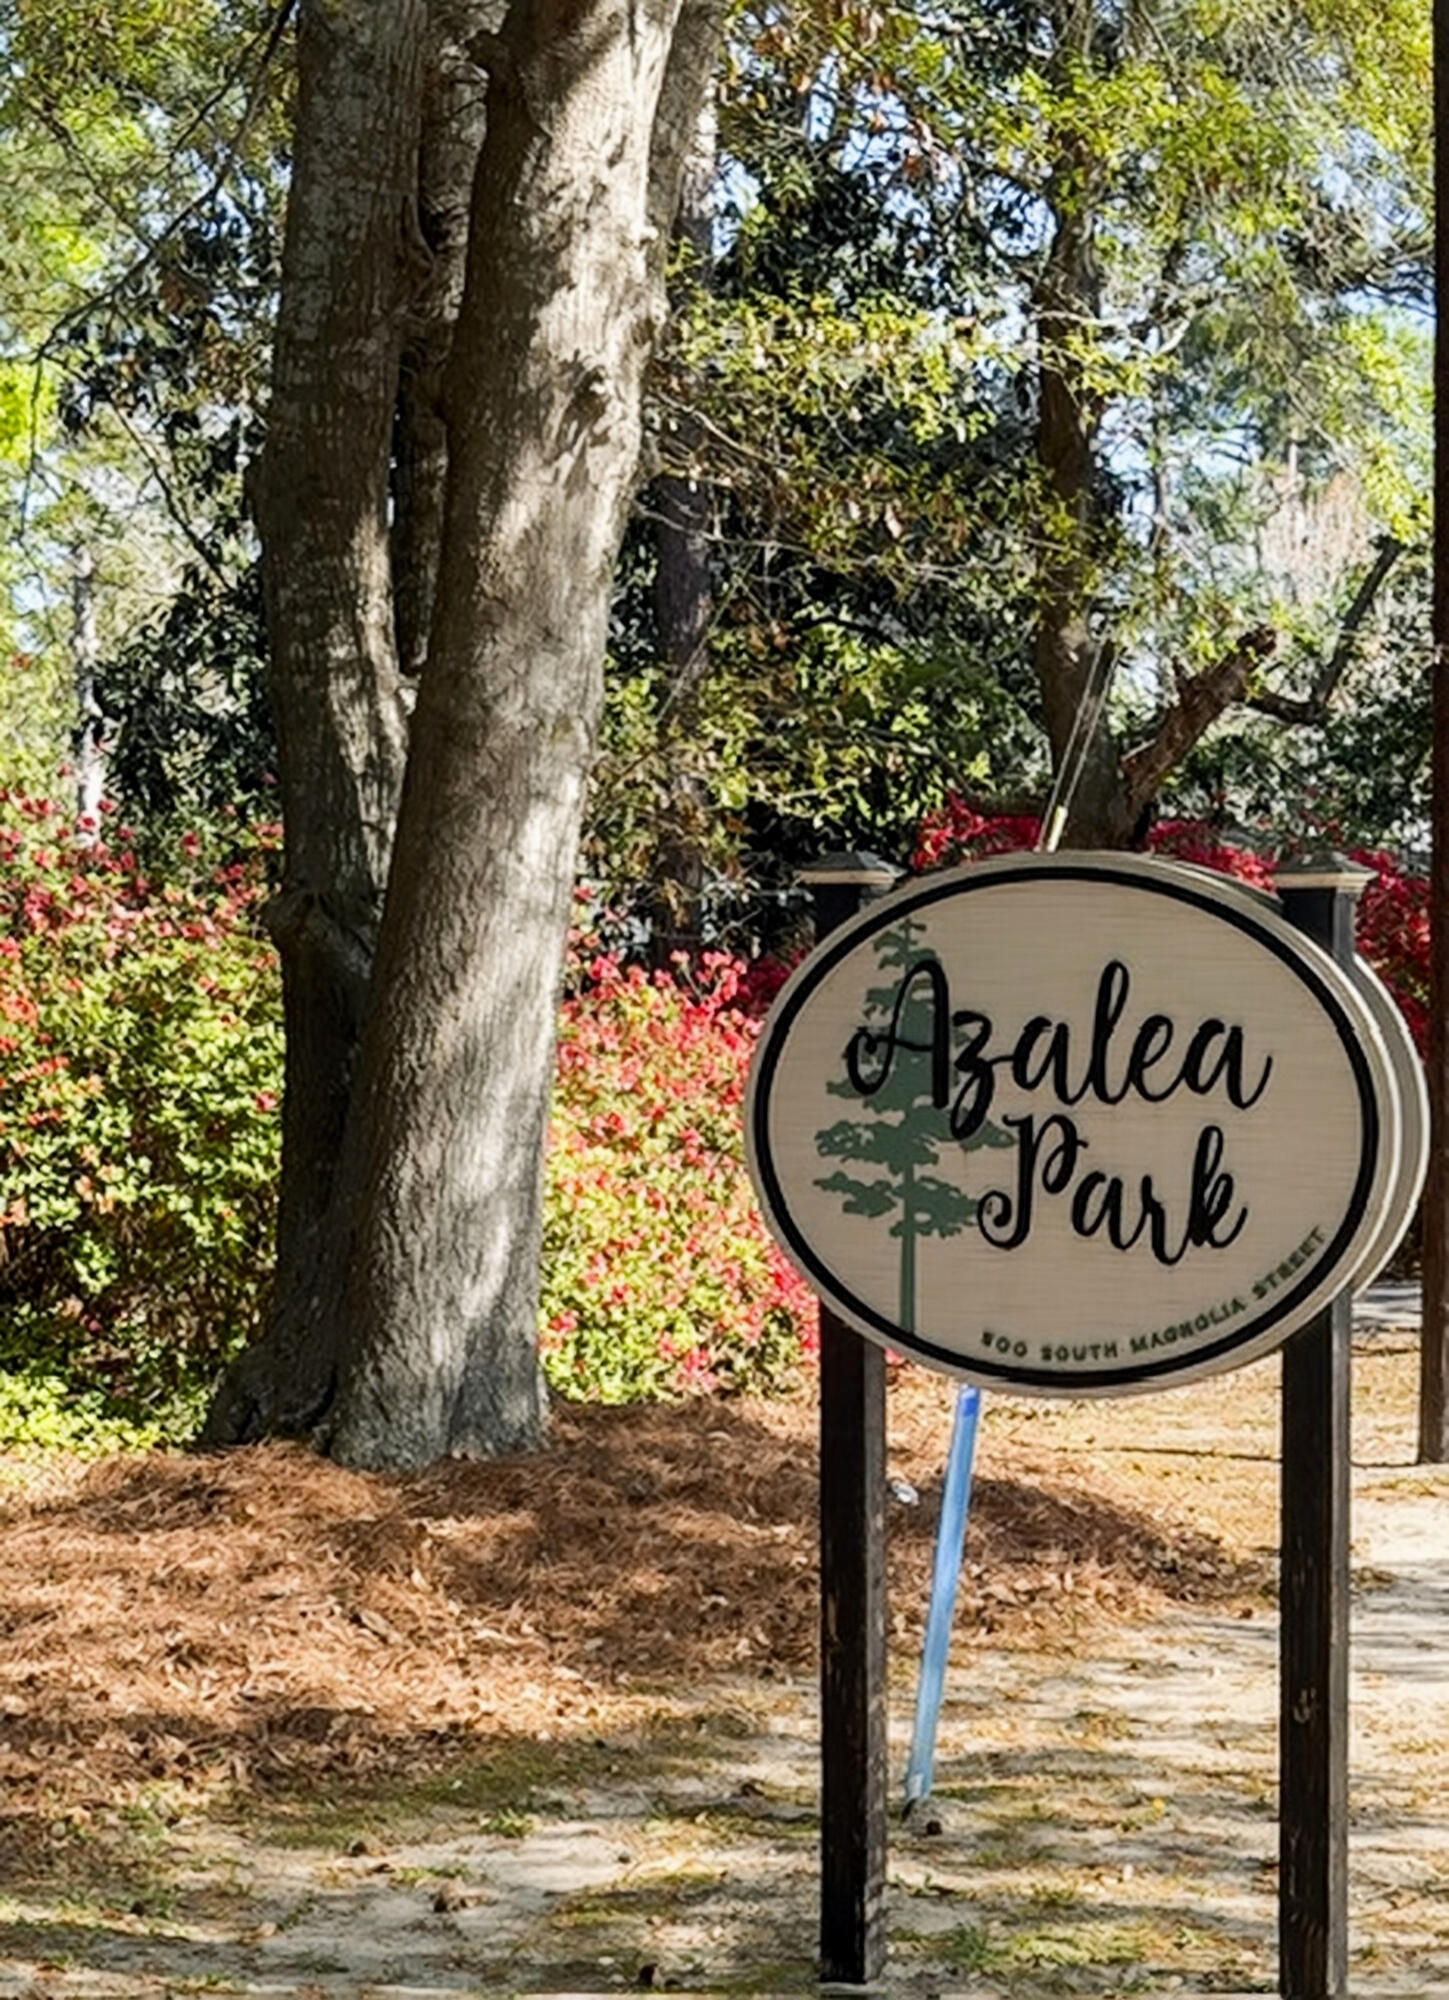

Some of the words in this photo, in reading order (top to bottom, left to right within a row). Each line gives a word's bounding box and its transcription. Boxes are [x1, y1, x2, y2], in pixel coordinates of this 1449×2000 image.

[847, 960, 1272, 1139] Azalea
[977, 1114, 1247, 1265] Park
[1040, 1341, 1118, 1362] SOUTH
[1129, 1297, 1247, 1354] MAGNOLIA
[1251, 1225, 1325, 1300] STREET
